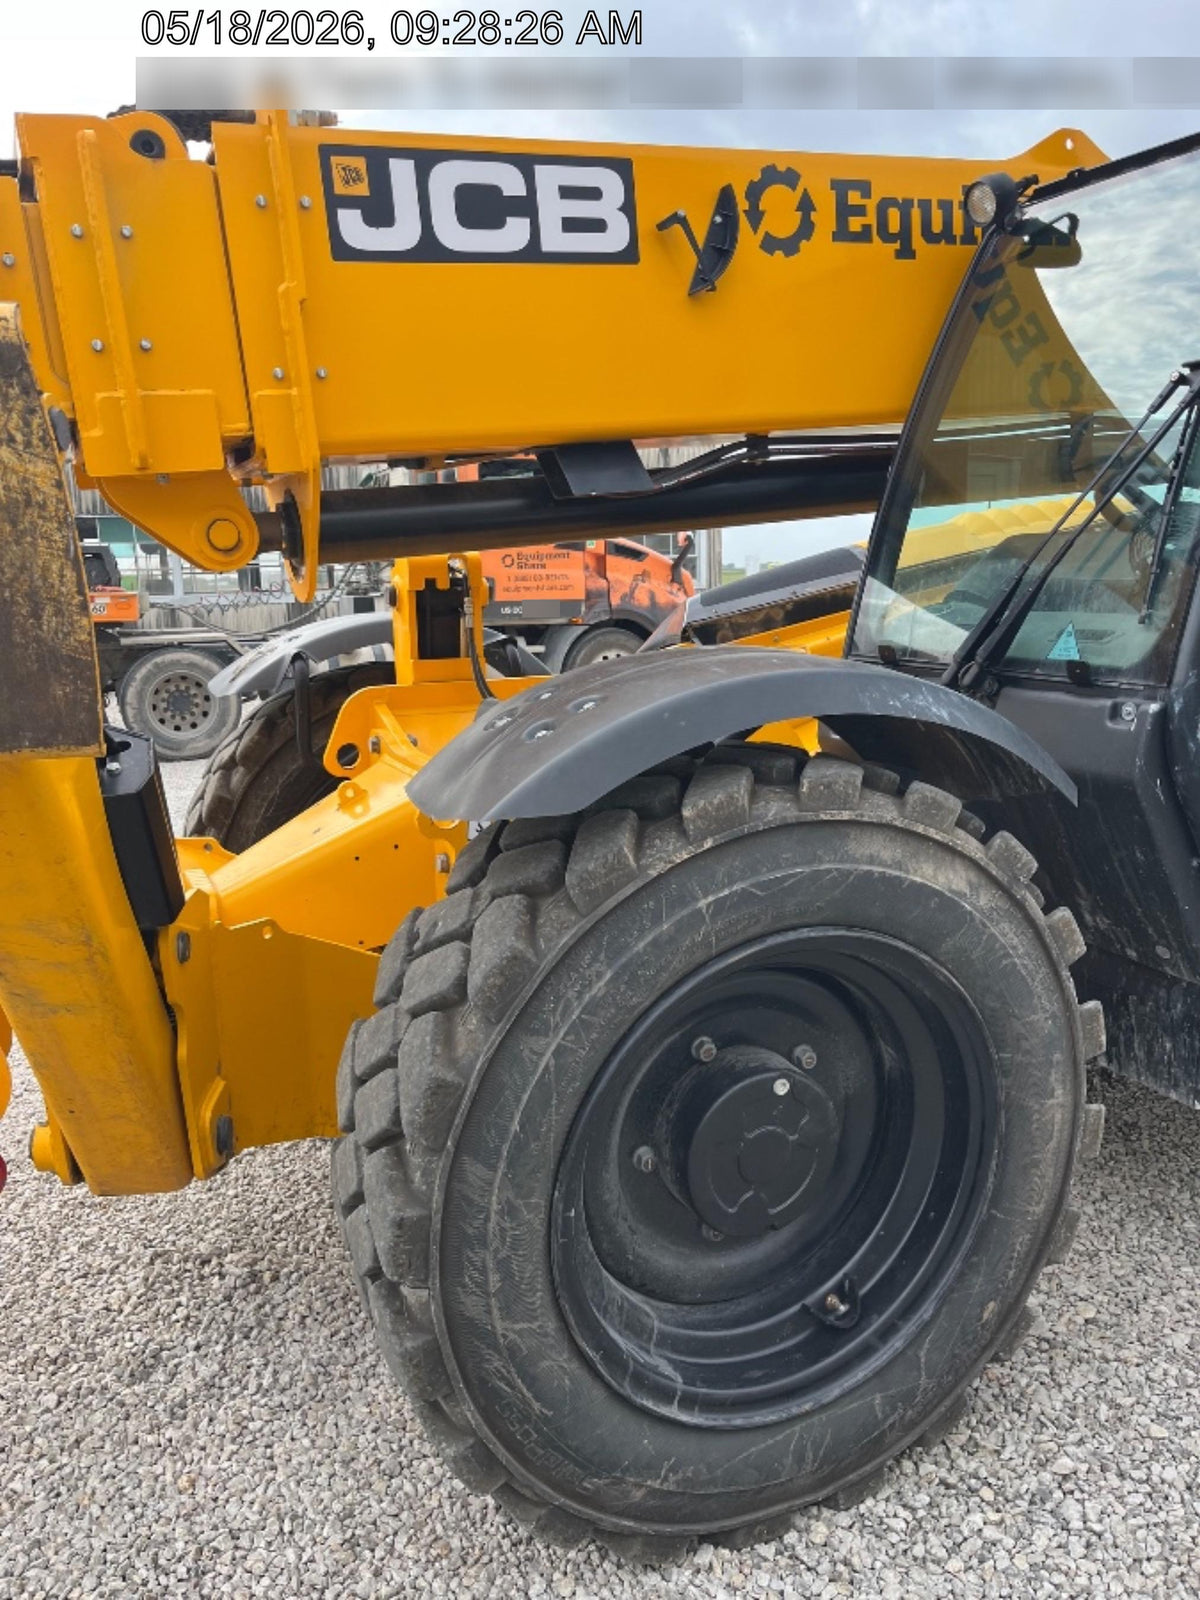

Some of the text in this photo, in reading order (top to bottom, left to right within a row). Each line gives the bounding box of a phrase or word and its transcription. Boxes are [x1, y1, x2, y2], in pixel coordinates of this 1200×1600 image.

[337, 157, 630, 253] JCB
[830, 178, 985, 260] Equi
[517, 551, 570, 561] Equipment
[517, 561, 546, 570] Share
